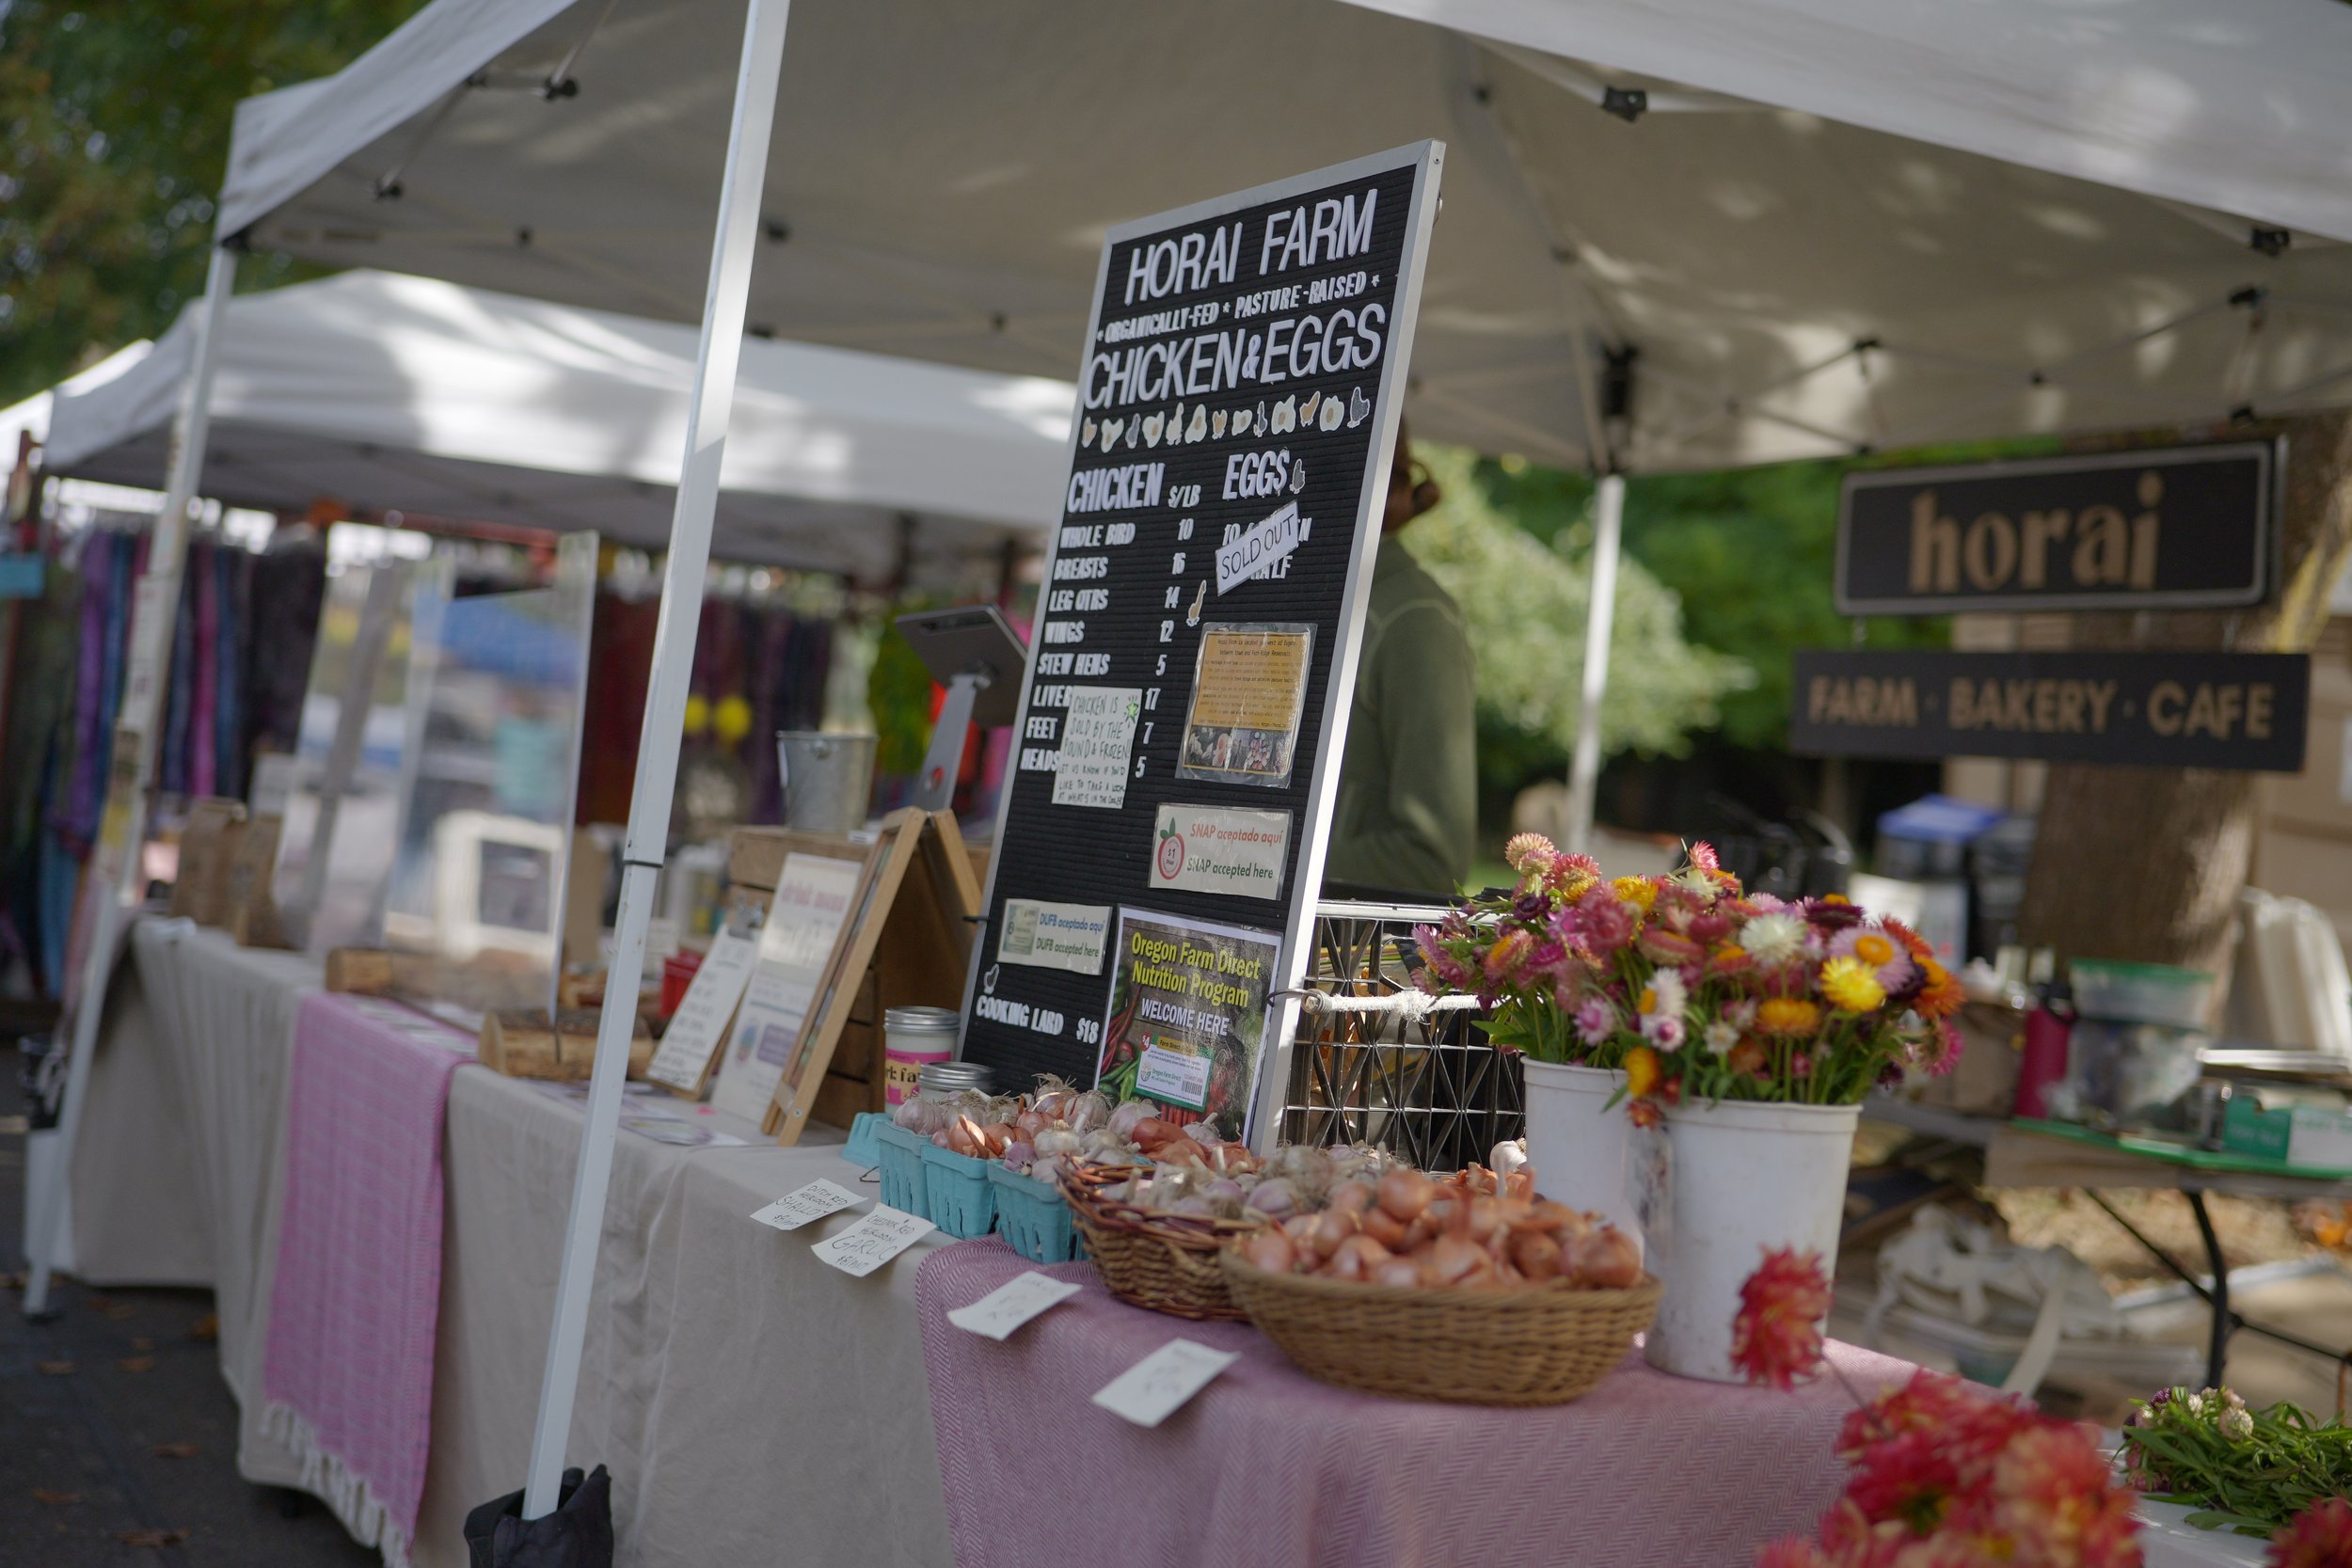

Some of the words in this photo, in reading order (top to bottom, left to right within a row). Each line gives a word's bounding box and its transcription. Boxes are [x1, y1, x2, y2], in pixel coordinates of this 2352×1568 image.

[1124, 222, 1243, 306] HORAI
[1259, 188, 1377, 276] FARM
[1104, 302, 1219, 343] ORGANICALLY-FED
[1067, 462, 1166, 514] CHICKEN
[1222, 449, 1291, 500] EGGS
[1059, 525, 1104, 548] WHOLE
[1104, 523, 1136, 546] BIRD
[1178, 518, 1194, 541] 10
[1222, 537, 1261, 580] SOLD
[1264, 514, 1295, 551] OUT
[1908, 471, 2163, 594] horai
[1054, 557, 1108, 580] BREASTS
[1172, 552, 1186, 575] 16
[1048, 590, 1074, 611] LEG
[1164, 586, 1181, 609] 14
[1044, 621, 1085, 643] WINGS
[1159, 620, 1174, 642] 12
[1037, 652, 1074, 675] STEW
[1073, 653, 1110, 675] HENS
[1155, 654, 1168, 676] 5
[1144, 688, 1161, 710] 17
[1808, 674, 1918, 728] FARM
[1947, 676, 2117, 735] BAKERY
[2147, 679, 2275, 739] CAFE
[1025, 717, 1058, 739] FEET
[1143, 722, 1154, 744] 7
[1106, 721, 1123, 739] THE
[1020, 748, 1060, 771] HEADS
[1135, 756, 1147, 778] 5
[1189, 823, 1216, 839] SNAP
[1217, 828, 1260, 844] aceptado
[1262, 829, 1284, 847] aquí
[1186, 858, 1212, 873] SNAP
[1213, 863, 1251, 879] accepted
[1253, 863, 1274, 879] here
[1058, 917, 1089, 931] aceptado
[1055, 942, 1083, 957] accepted
[1084, 942, 1099, 958] here
[1132, 932, 1177, 964] Oregon
[1180, 942, 1215, 970] Farm
[1217, 949, 1261, 979] Direct
[1132, 960, 1187, 993] Nutrition
[1189, 973, 1249, 1008] Program
[976, 995, 1029, 1027] COOKING
[1031, 1008, 1064, 1036] LARD
[1076, 1017, 1100, 1044] $18
[1141, 998, 1195, 1028] WELCOME
[1197, 1011, 1231, 1037] HERE
[832, 1235, 897, 1260] GARLIC
